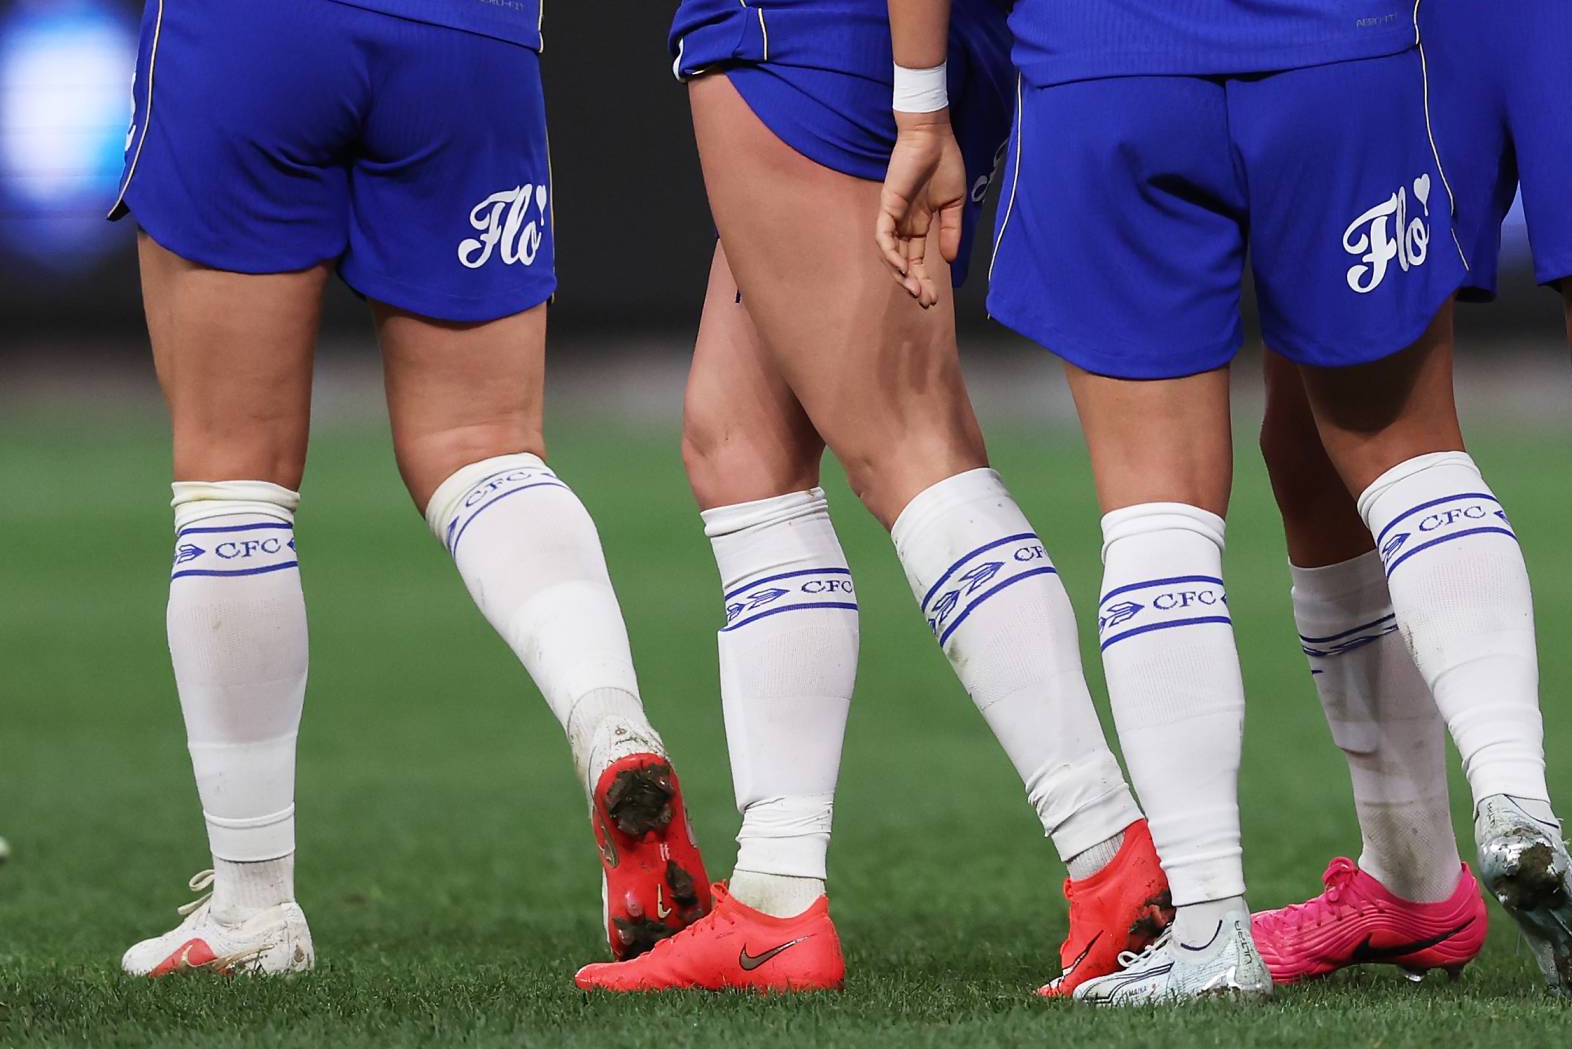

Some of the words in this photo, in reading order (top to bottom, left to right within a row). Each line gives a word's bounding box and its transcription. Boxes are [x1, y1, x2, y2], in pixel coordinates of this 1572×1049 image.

[458, 184, 542, 268] Flo
[1343, 186, 1430, 293] Flo
[466, 472, 532, 507] CFC
[1419, 506, 1486, 531] CFC
[215, 539, 281, 559] CFC
[1153, 590, 1217, 610] CFC
